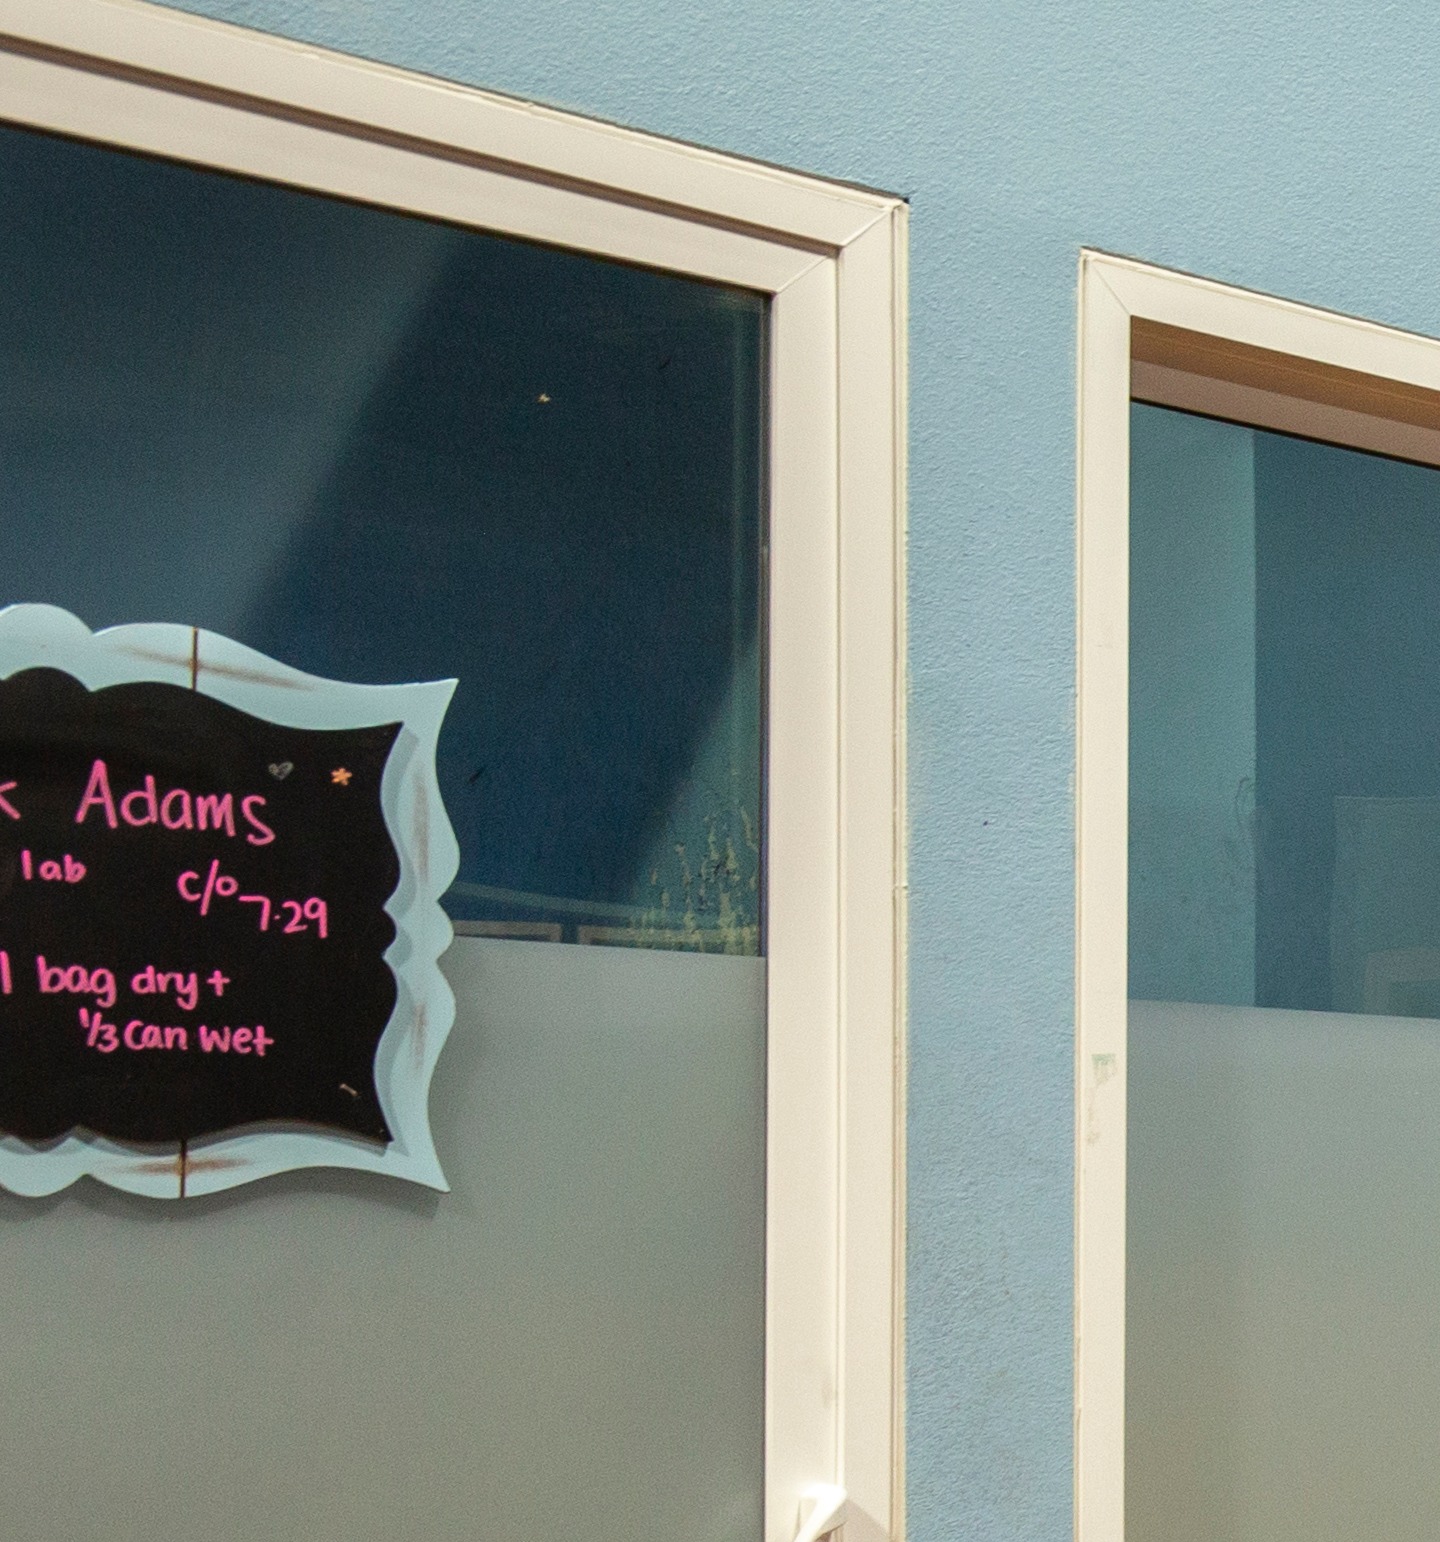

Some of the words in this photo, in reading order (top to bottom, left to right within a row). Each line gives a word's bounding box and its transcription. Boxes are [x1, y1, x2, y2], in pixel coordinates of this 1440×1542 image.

[75, 759, 275, 845] Adams
[21, 849, 87, 883] lab
[176, 858, 238, 916] c/o
[238, 896, 328, 939] 7.29
[36, 955, 117, 1008] bag
[131, 965, 198, 1011] dry
[206, 969, 231, 996] +
[79, 1007, 119, 1053] 1/3
[199, 1024, 274, 1057] wet
